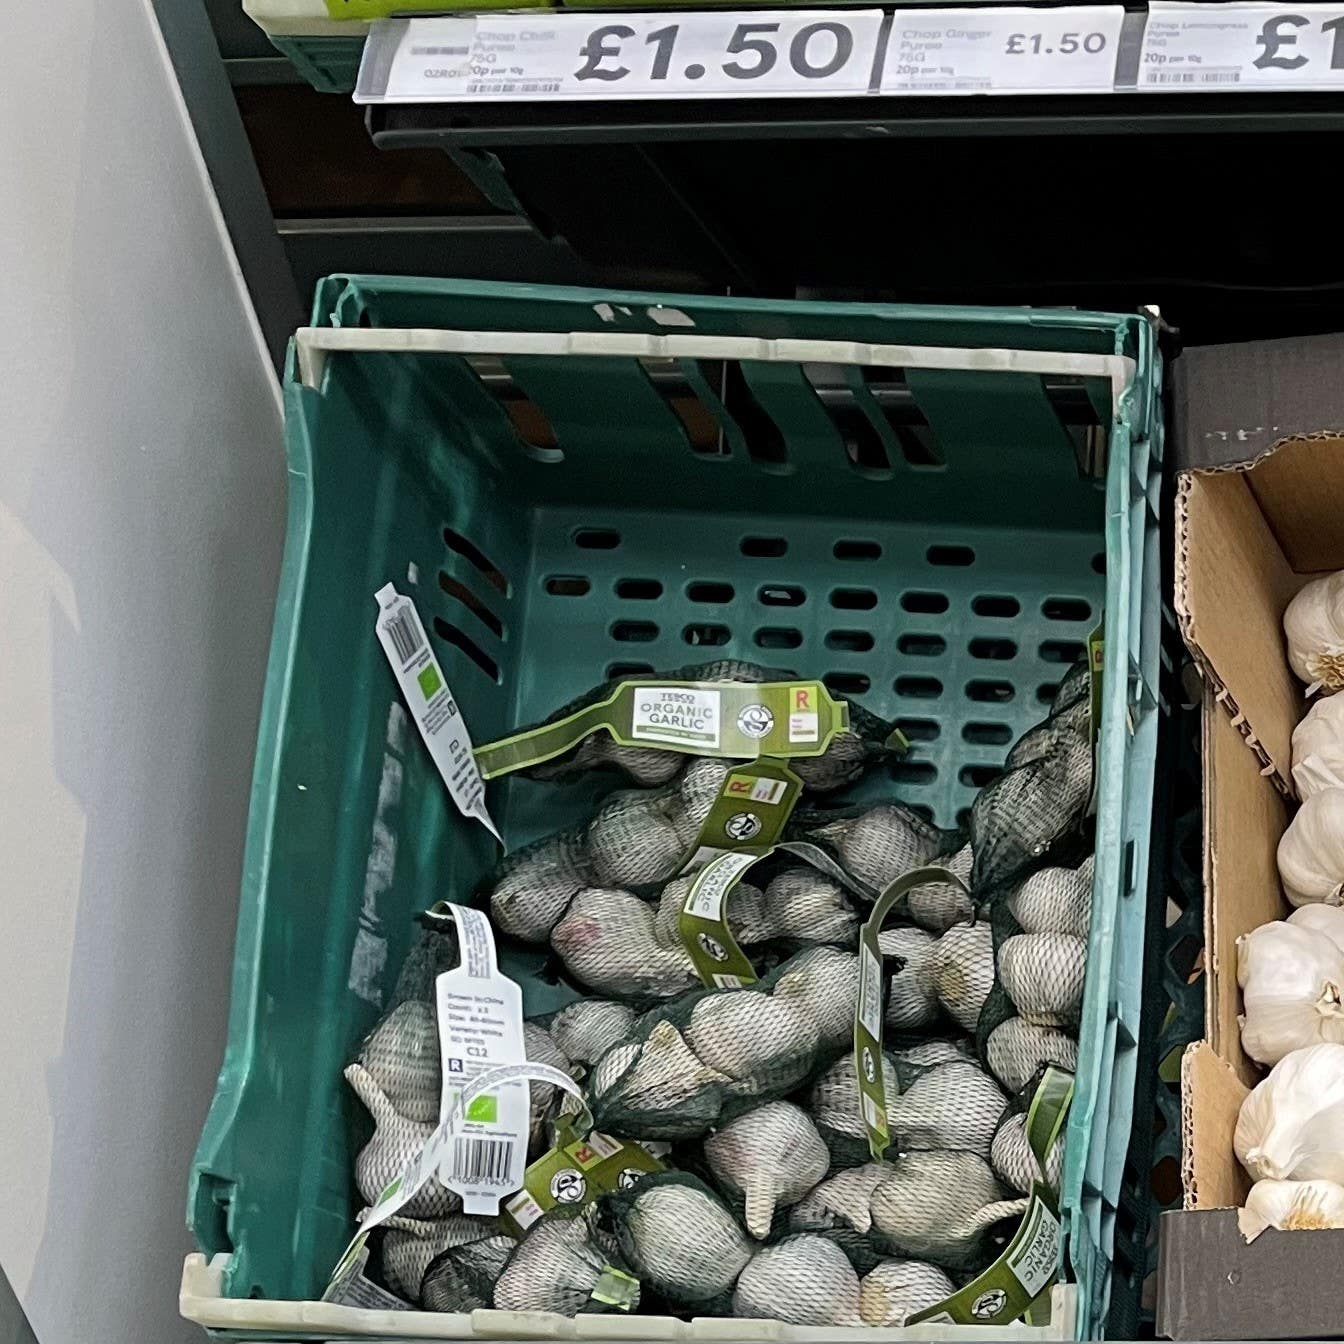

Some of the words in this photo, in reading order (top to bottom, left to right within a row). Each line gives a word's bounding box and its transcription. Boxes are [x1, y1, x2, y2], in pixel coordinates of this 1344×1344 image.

[573, 22, 854, 82] £1.50
[1005, 32, 1107, 55] £1.50
[660, 692, 696, 705] TESCO
[640, 703, 713, 721] ORGANIC
[649, 713, 705, 730] GARLIC
[466, 1047, 488, 1058] C12
